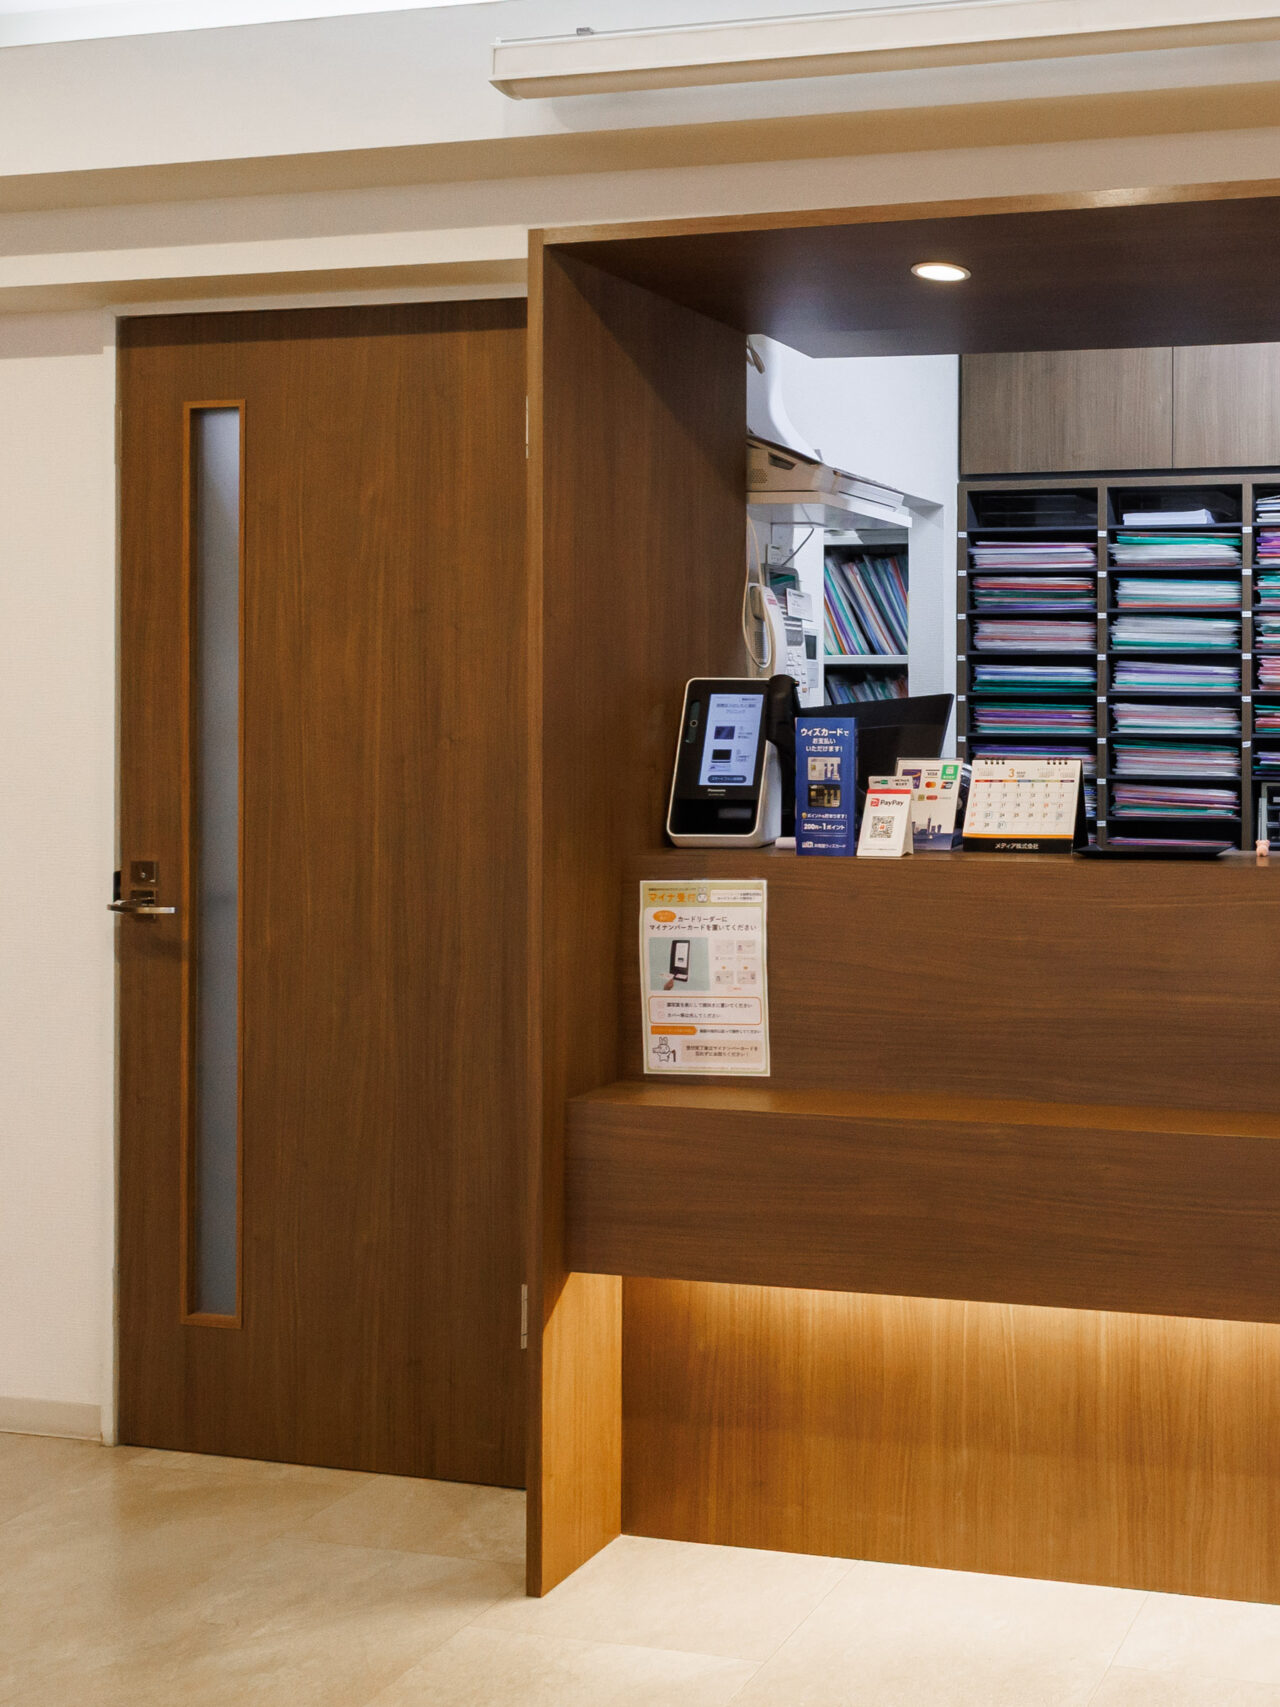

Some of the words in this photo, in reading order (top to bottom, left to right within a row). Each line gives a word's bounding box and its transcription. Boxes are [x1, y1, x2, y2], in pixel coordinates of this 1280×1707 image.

[800, 728, 850, 737] ウィズカードで
[1008, 768, 1015, 778] 3
[880, 799, 904, 807] PayPay
